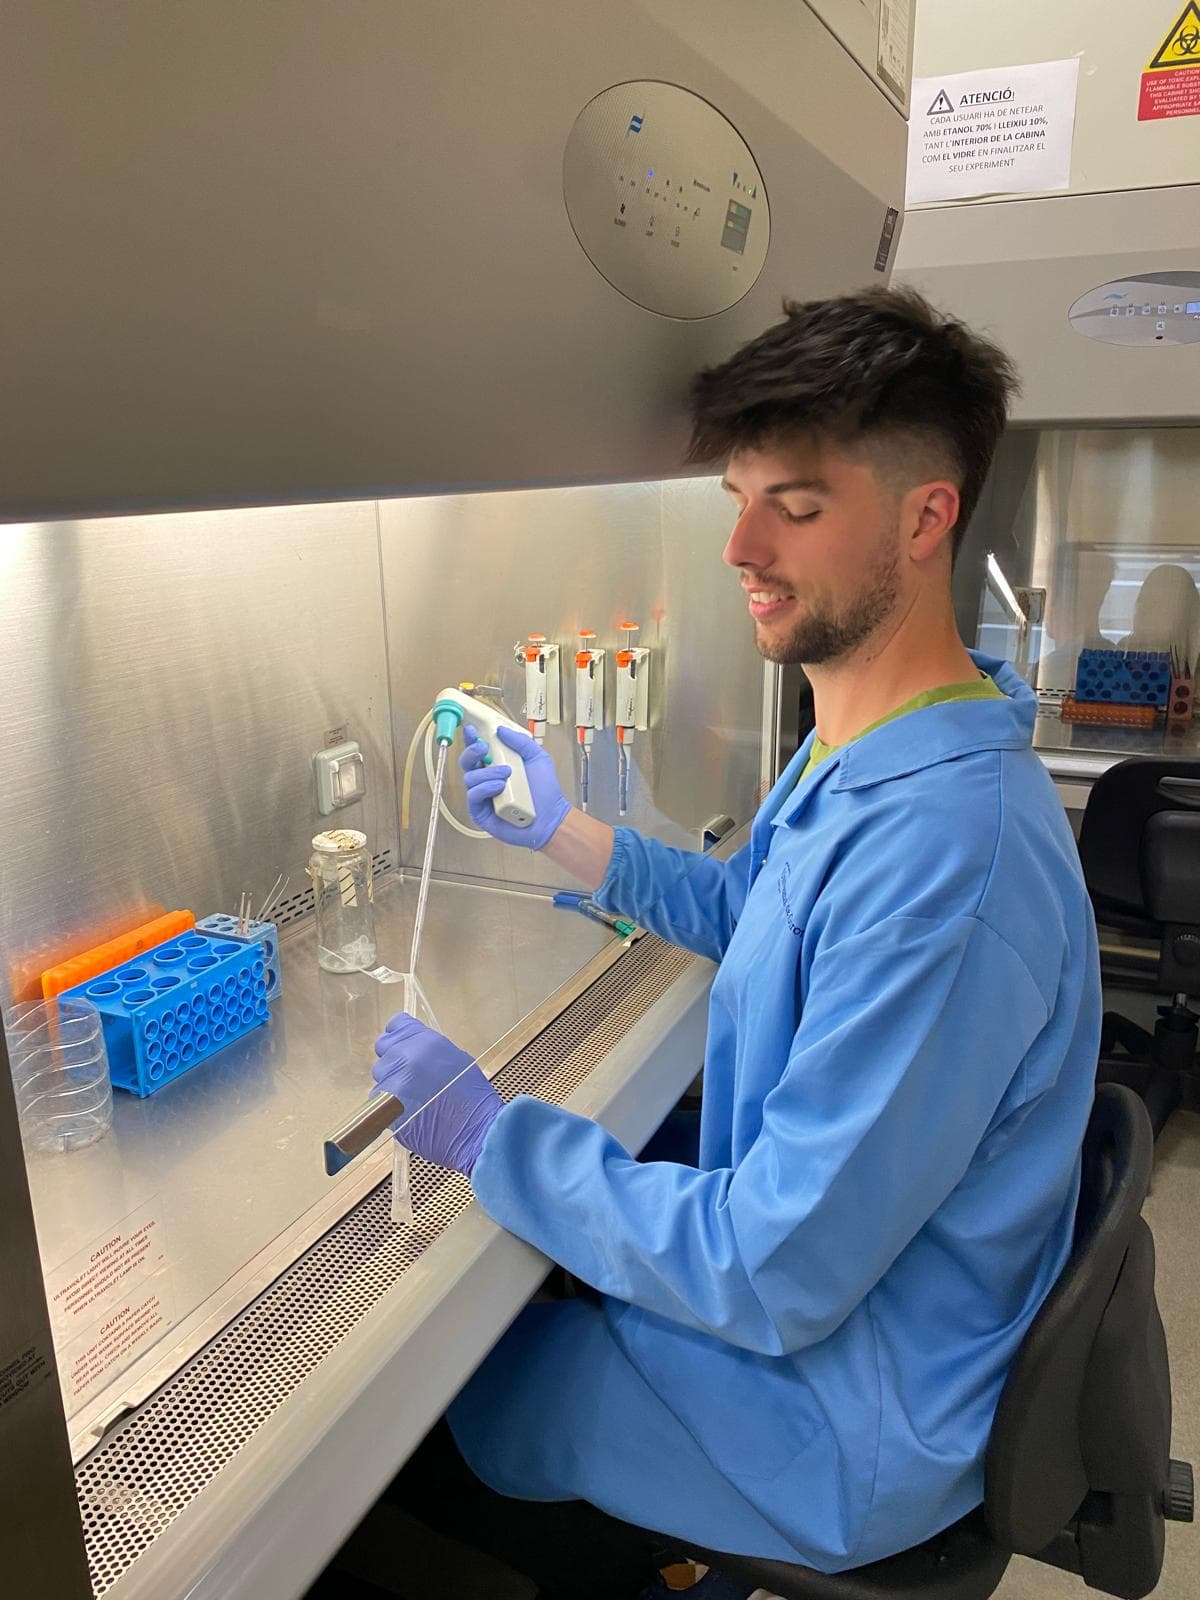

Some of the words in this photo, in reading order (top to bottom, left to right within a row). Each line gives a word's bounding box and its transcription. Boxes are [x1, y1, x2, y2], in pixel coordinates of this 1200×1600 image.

[930, 115, 951, 125] CADA
[954, 112, 982, 122] USUARI
[983, 109, 995, 118] HA
[997, 108, 1007, 117] DE
[1009, 104, 1044, 115] NETEJAR
[923, 129, 941, 139] AMB
[943, 125, 974, 136] ETANOL
[975, 122, 992, 132] 70%
[998, 118, 1027, 129] LLEIXIU
[1029, 117, 1048, 126] 10%,
[924, 141, 944, 151] TANT
[946, 136, 988, 148] L'INTERIOR
[990, 134, 1001, 142] DE
[1003, 132, 1013, 141] LA
[1014, 130, 1046, 140] CABINA
[922, 154, 941, 164] COM
[942, 153, 951, 161] EL
[952, 150, 976, 159] VIDRE
[977, 149, 988, 157] EN
[990, 143, 1035, 155] FINALITZAR
[1036, 142, 1046, 150] EL
[948, 164, 964, 173] SEU
[965, 158, 1015, 171] EXPERIMENT
[90, 1235, 121, 1263] CAUTION
[53, 1272, 86, 1302] ULTRAVIOLET
[87, 1262, 101, 1275] LIGHT
[88, 1276, 119, 1304] ULTRAVIOLET
[100, 1306, 131, 1335] CAUTION
